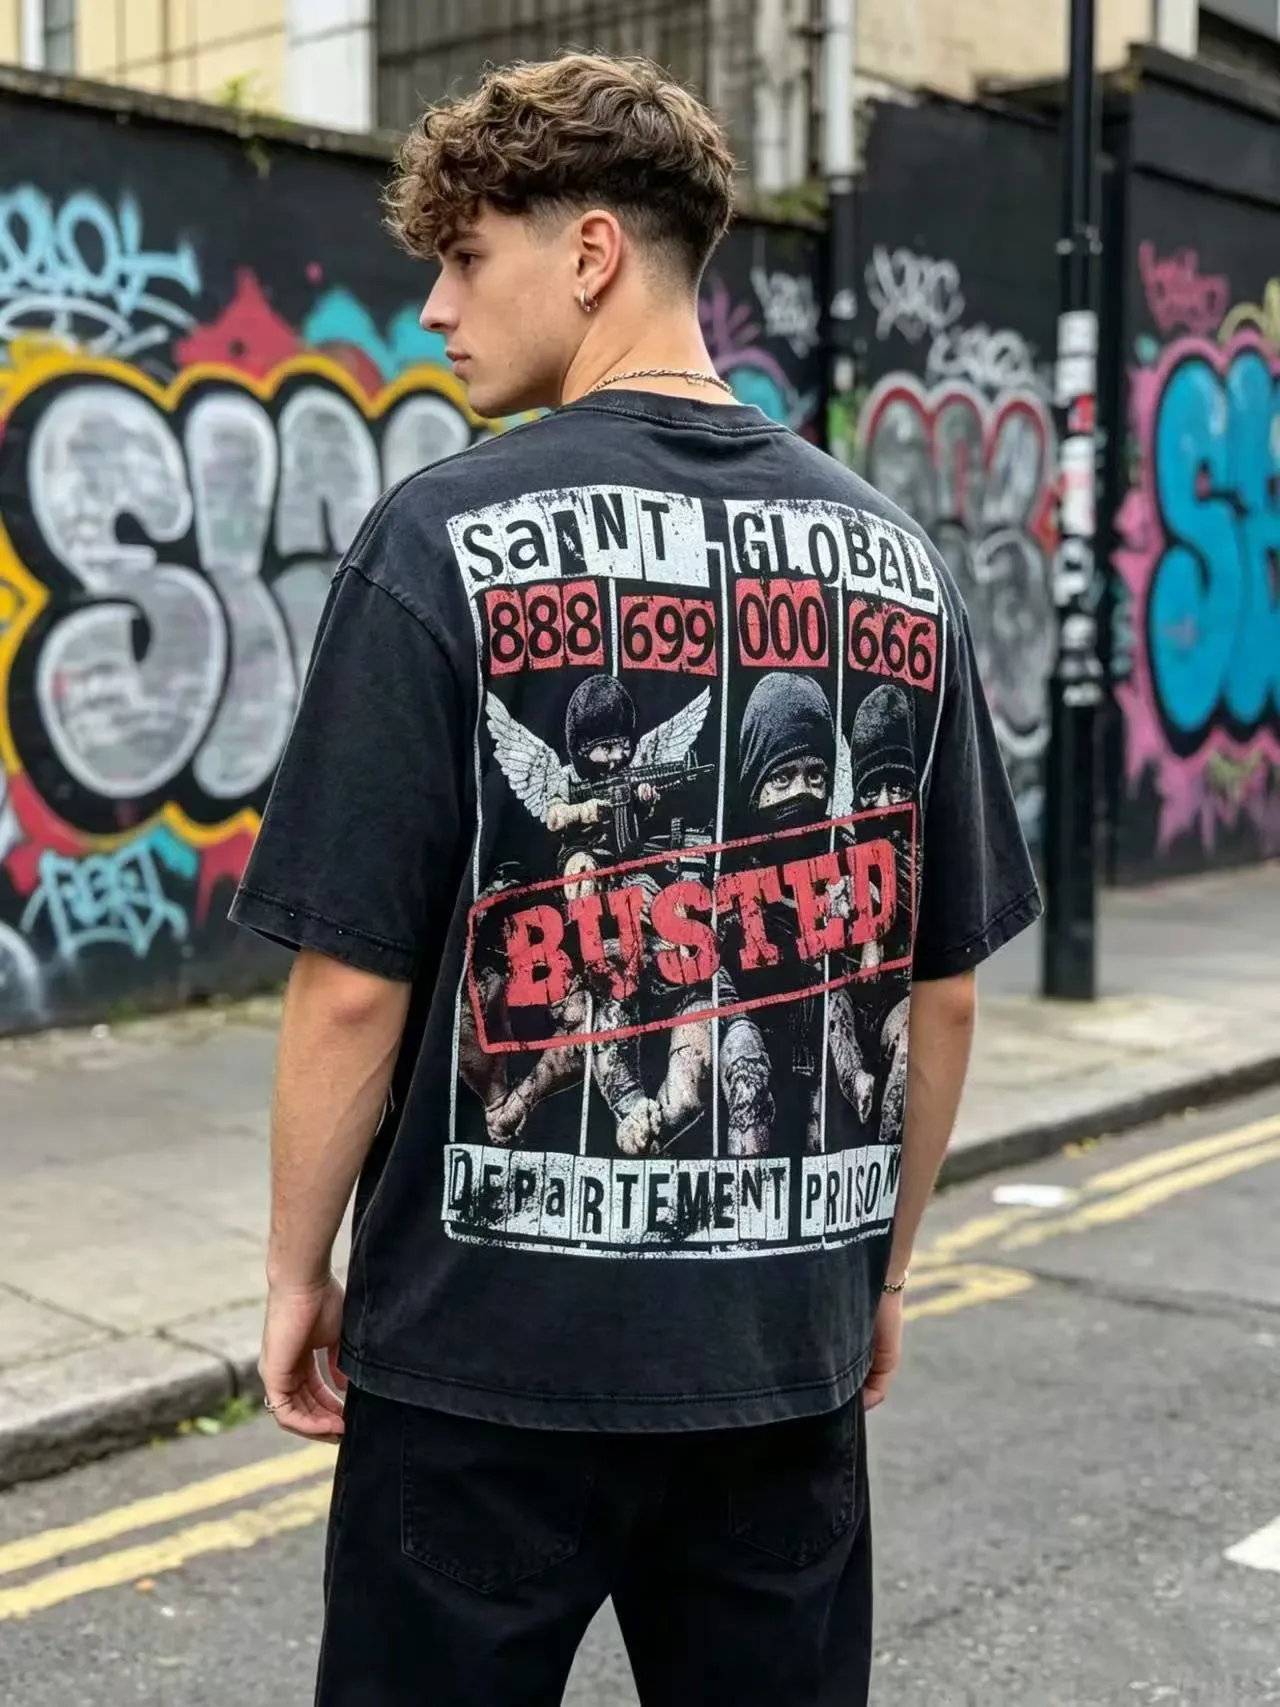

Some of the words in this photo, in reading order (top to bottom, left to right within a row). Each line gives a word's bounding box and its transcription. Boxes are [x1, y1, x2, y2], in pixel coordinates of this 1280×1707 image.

[733, 511, 934, 601] GLOBAL
[491, 591, 602, 664] 888
[623, 595, 715, 668] 699
[739, 593, 826, 661] 000
[850, 607, 932, 681] 666
[504, 838, 897, 1006] BUSTED
[806, 1149, 900, 1227] PRISON
